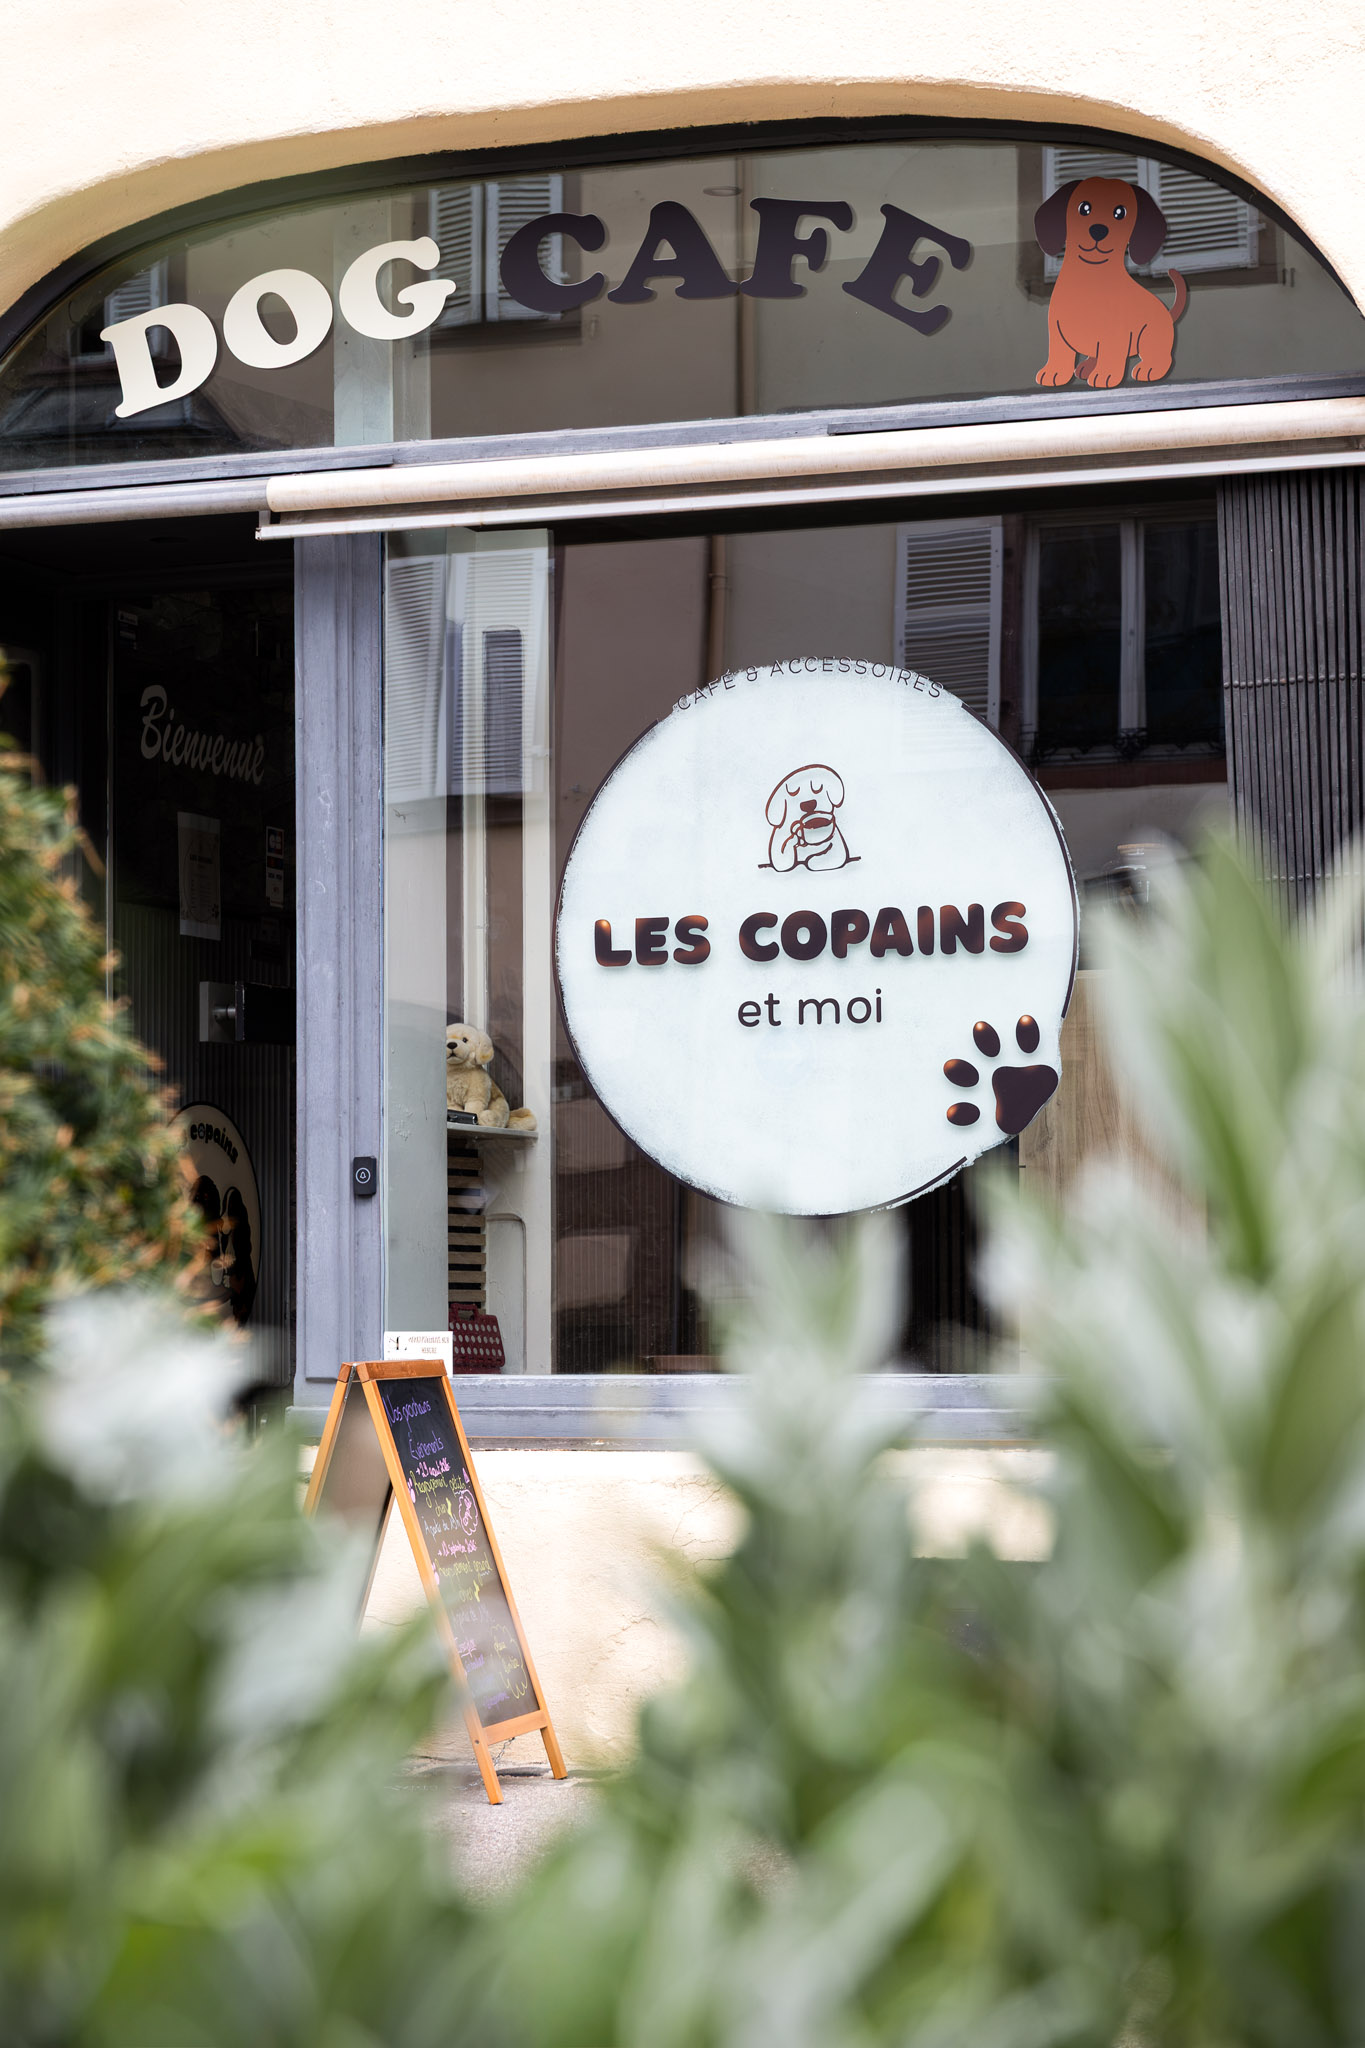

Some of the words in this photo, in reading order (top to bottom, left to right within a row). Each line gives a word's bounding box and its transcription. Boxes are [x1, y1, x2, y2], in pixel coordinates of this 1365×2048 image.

[99, 236, 457, 419] DOG
[500, 197, 972, 336] CAFE
[676, 668, 736, 711] CAFÉ
[745, 664, 759, 682] &
[769, 656, 944, 699] ACCESSOIRES
[140, 685, 265, 785] Bienvenue
[594, 914, 711, 967] LES
[738, 901, 1029, 962] COPAINS
[738, 993, 781, 1027] et
[799, 988, 883, 1025] moi
